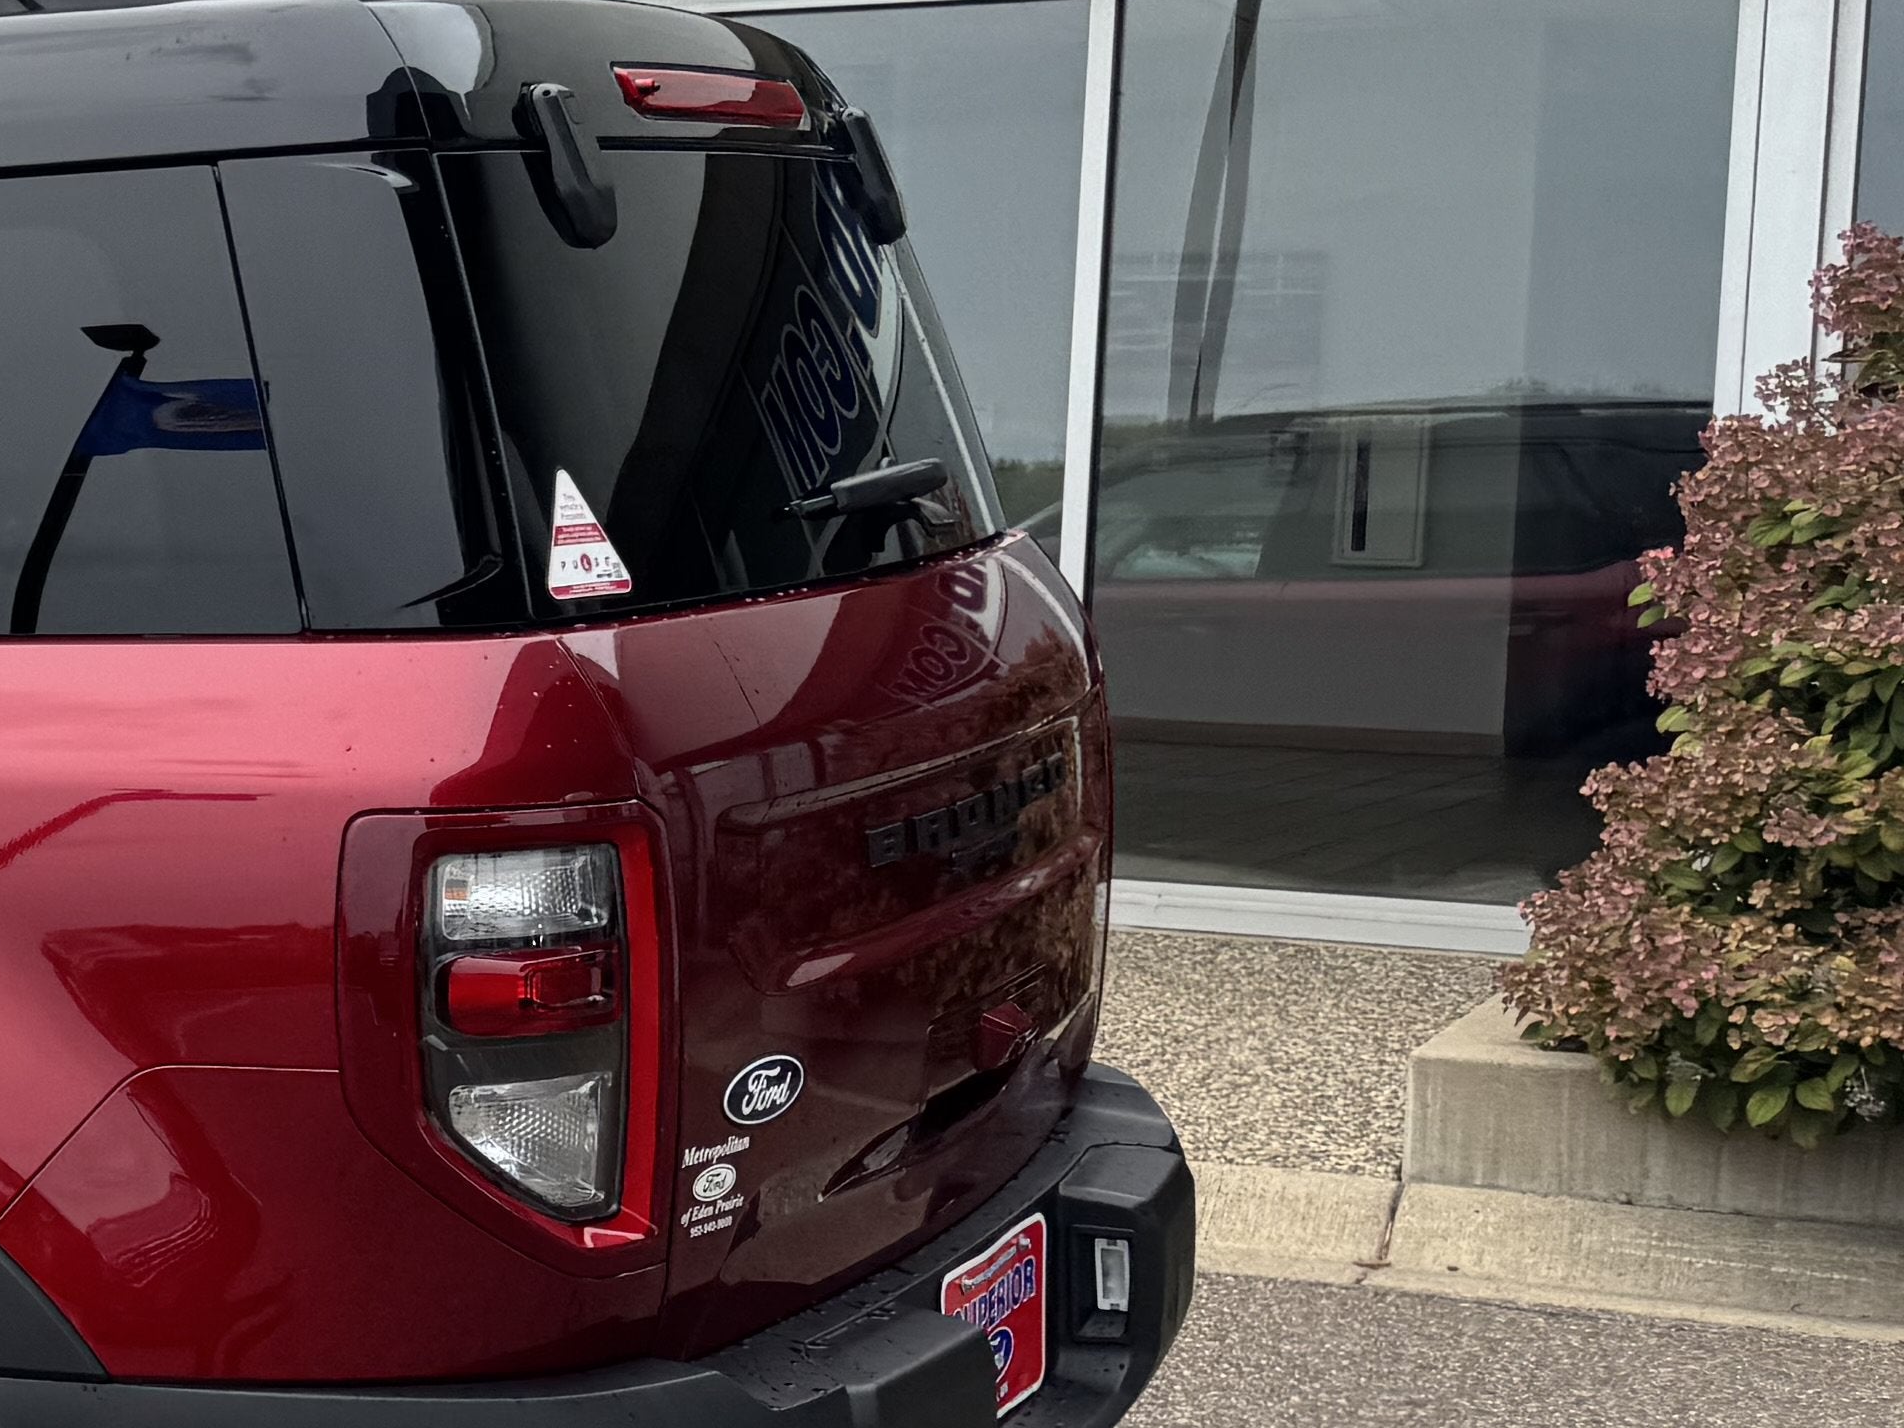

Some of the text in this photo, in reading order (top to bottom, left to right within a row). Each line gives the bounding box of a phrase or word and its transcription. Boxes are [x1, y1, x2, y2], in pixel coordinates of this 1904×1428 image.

[741, 1065, 793, 1116] Ford
[681, 1135, 751, 1169] Metropolitan
[680, 1193, 745, 1228] of Eden Prairie
